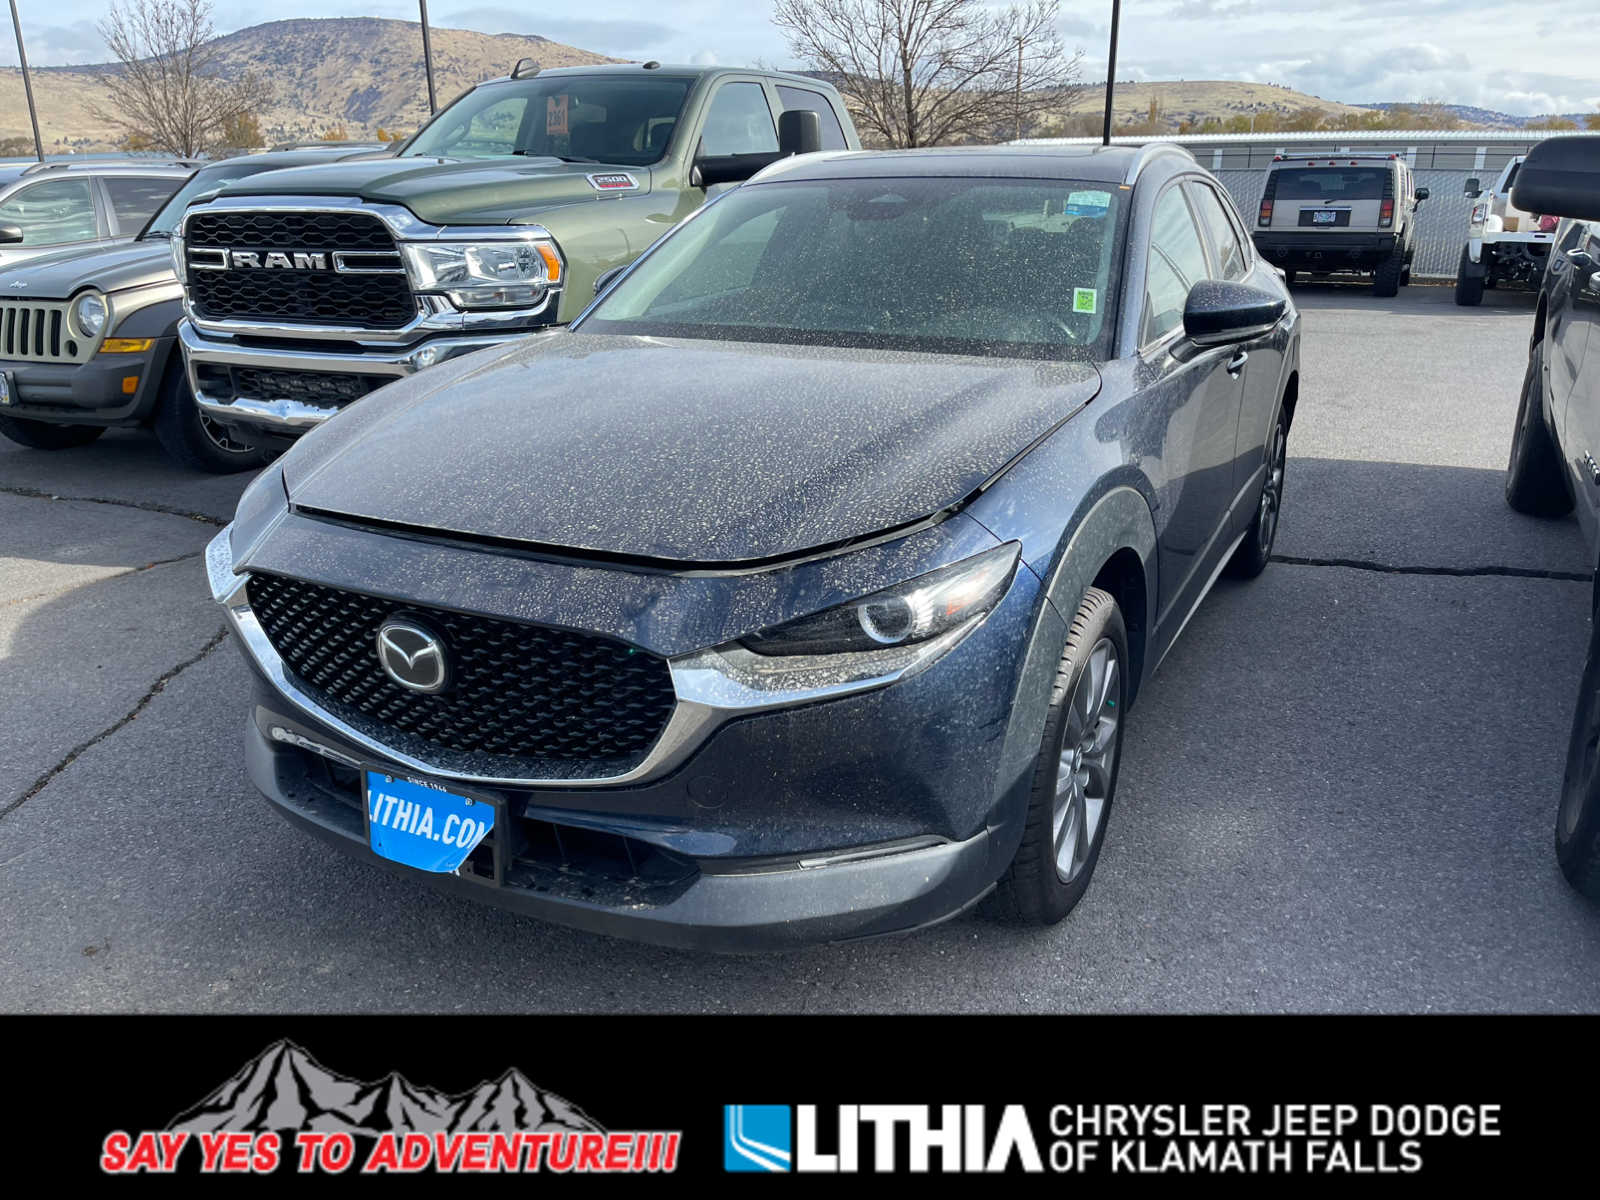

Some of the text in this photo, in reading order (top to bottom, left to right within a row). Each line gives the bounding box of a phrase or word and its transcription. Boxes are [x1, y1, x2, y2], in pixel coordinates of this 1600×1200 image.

[596, 175, 627, 183] 2500
[232, 251, 328, 270] RAM
[407, 776, 428, 788] SINCE
